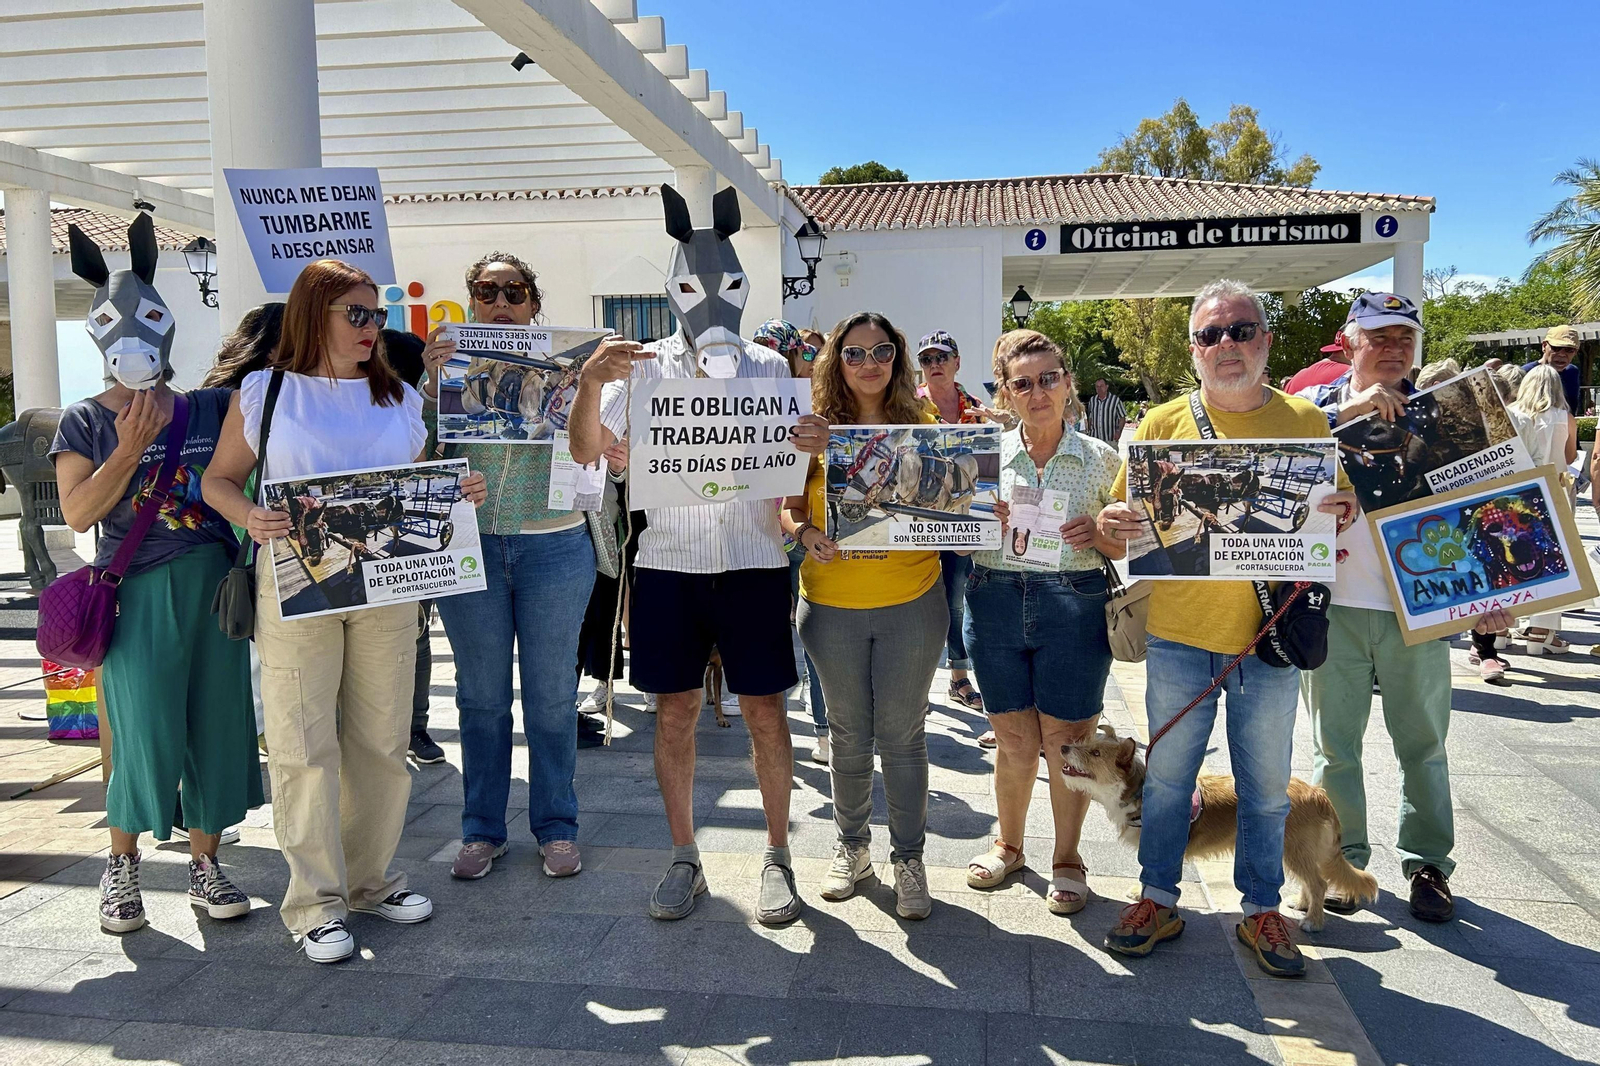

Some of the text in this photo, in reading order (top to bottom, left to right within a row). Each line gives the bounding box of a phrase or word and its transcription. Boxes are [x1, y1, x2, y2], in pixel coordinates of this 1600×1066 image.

[240, 185, 376, 204] NUNCA ME DEJAN
[260, 211, 372, 234] TUMBARME
[1072, 219, 1349, 249] Oficina de turismo
[271, 238, 375, 259] A DESCANSAR
[460, 330, 503, 338] SINTIENTES
[459, 340, 531, 350] NO SON TAXIS
[652, 397, 800, 416] ME OBLIGAN A
[650, 426, 756, 445] TRABAJAR
[648, 452, 796, 473] 365 DÍAS DEL AÑO
[1430, 444, 1514, 485] ENCADENADOS
[1436, 458, 1515, 494] SIN PODER TUMBARSE
[721, 484, 750, 492] PACMA
[909, 523, 981, 533] NO SON TAXIS
[1222, 538, 1304, 548] TODA UNA VIDA
[374, 555, 454, 574] TODA UNA VIDA
[1214, 549, 1304, 561] DE EXPLOTACIÓN
[369, 566, 456, 588] DE EXPLOTACIÓN
[392, 579, 457, 594] #CORTASUCUERDA
[1414, 571, 1484, 602] AMMA
